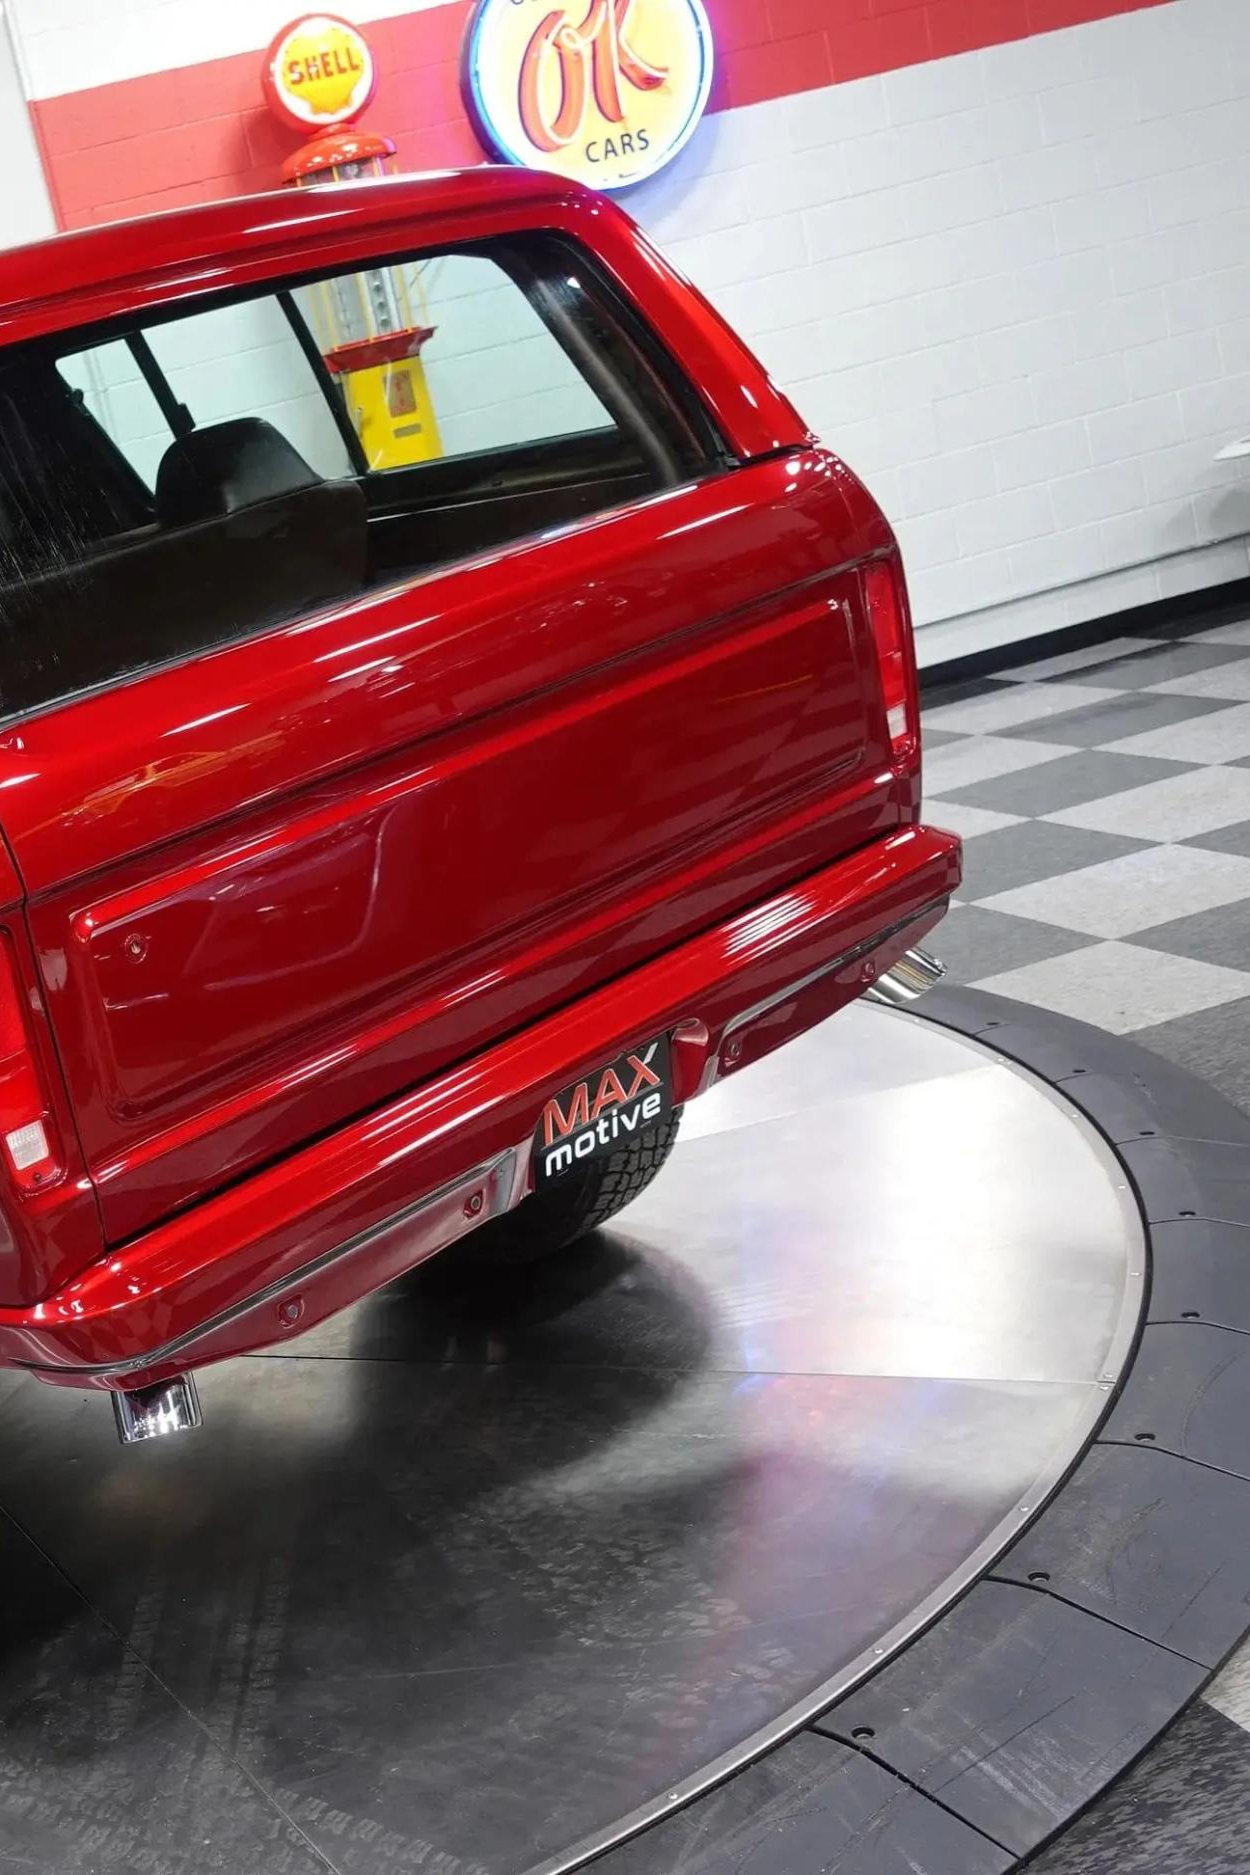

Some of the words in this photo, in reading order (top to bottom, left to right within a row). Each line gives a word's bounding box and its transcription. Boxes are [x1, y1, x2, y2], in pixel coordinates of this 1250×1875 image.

[287, 47, 360, 85] SHELL
[518, 0, 669, 153] OK
[585, 129, 650, 163] CARS
[543, 1042, 661, 1146] MAX
[545, 1092, 661, 1177] motive
